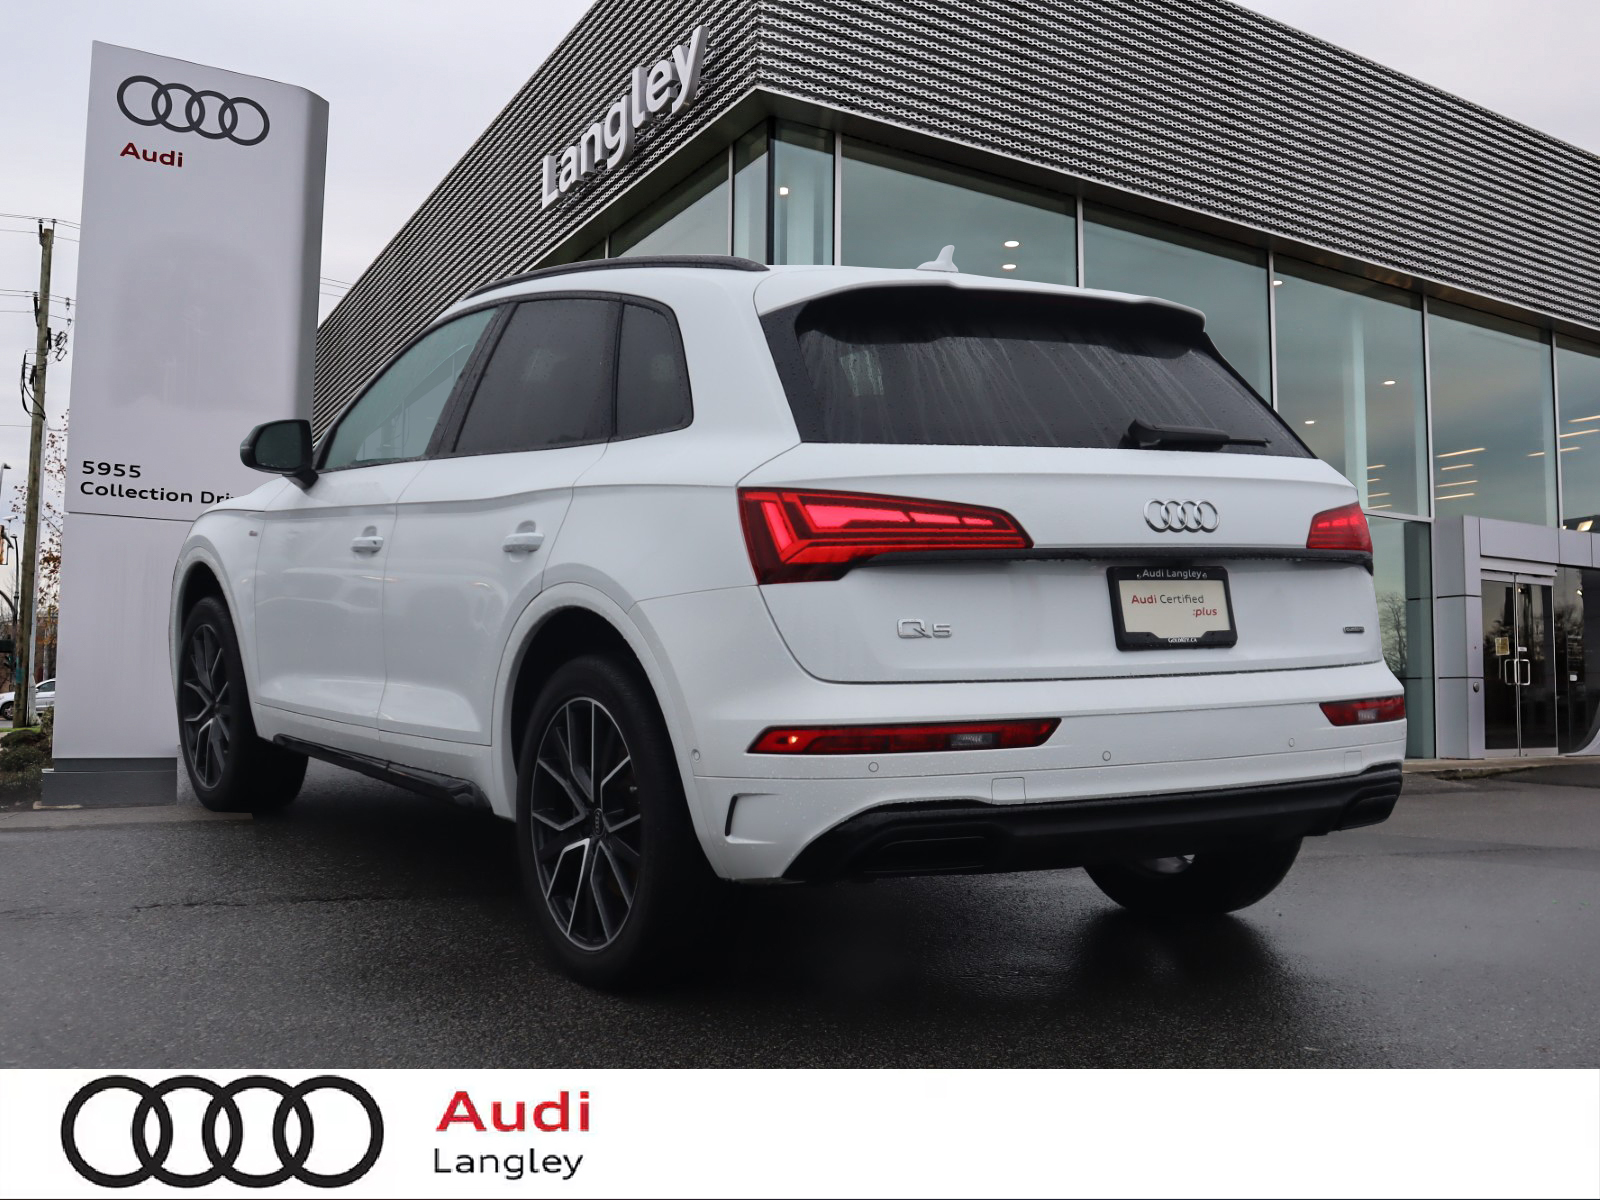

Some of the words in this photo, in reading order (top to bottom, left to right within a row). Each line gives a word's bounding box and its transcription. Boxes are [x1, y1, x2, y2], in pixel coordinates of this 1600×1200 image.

[542, 25, 710, 210] Langley
[120, 142, 183, 168] Audi
[82, 460, 142, 478] 5955
[80, 481, 193, 503] Collection
[200, 491, 234, 504] Dri
[1142, 569, 1164, 578] Audi
[1166, 569, 1202, 579] Langley
[1131, 595, 1157, 604] Audi
[1159, 594, 1204, 604] Certified
[1192, 607, 1217, 617] :plus
[897, 619, 952, 639] Q5
